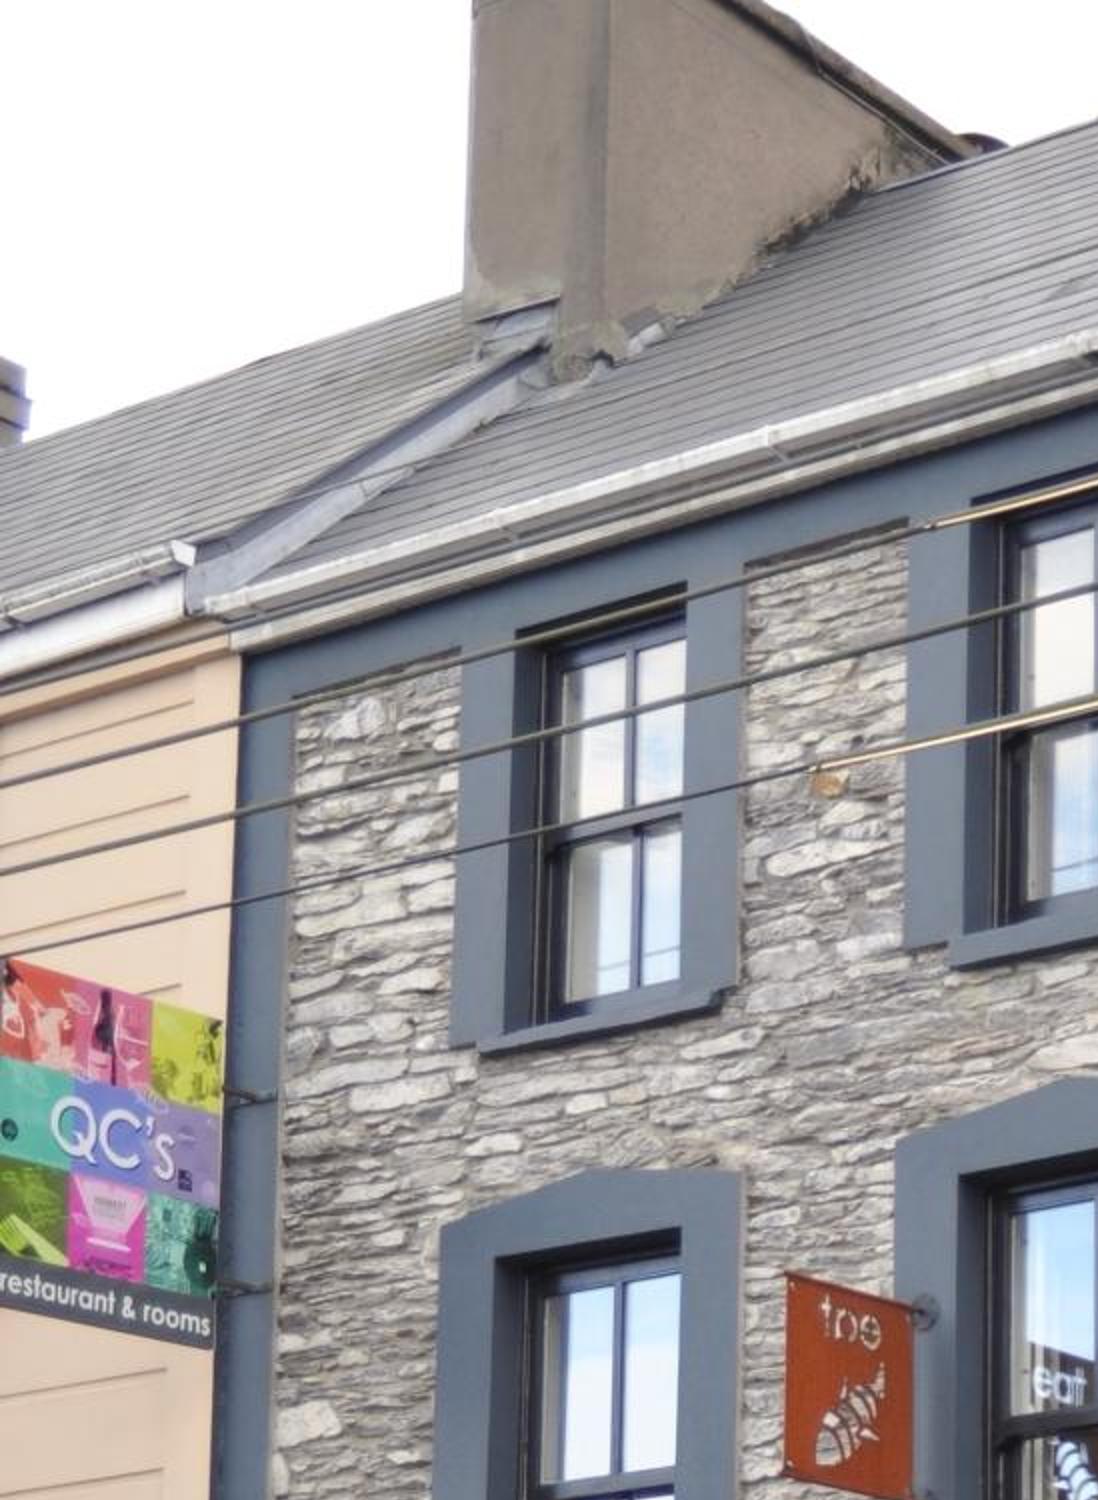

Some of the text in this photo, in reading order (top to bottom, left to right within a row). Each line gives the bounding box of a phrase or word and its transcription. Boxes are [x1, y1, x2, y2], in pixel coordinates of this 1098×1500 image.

[49, 1096, 176, 1181] QC's
[0, 1272, 211, 1337] restaurant & rooms
